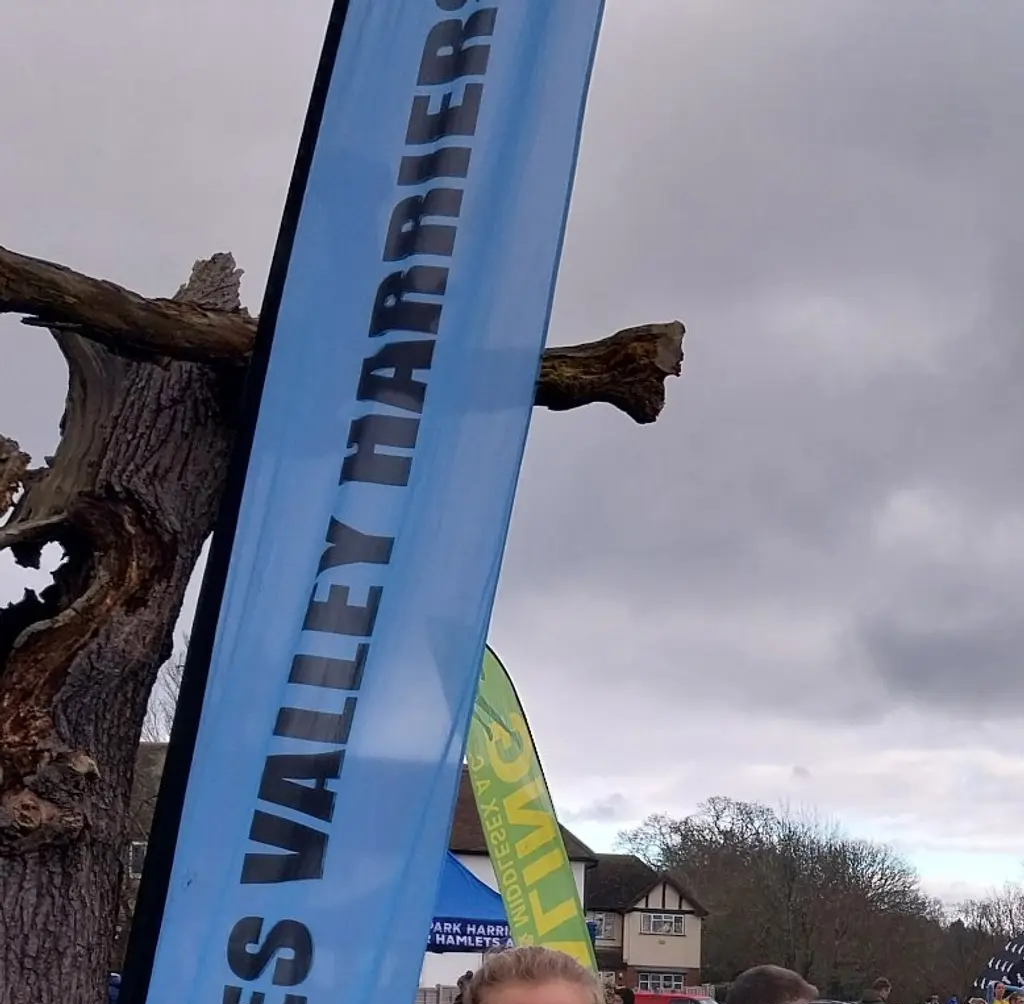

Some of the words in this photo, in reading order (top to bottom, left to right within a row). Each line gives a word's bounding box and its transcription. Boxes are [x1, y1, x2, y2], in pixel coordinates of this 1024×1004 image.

[241, 515, 395, 884] VALLEY
[339, 0, 498, 486] HARRIER
[467, 923, 512, 937] HARRI
[436, 934, 500, 948] HAMLETS
